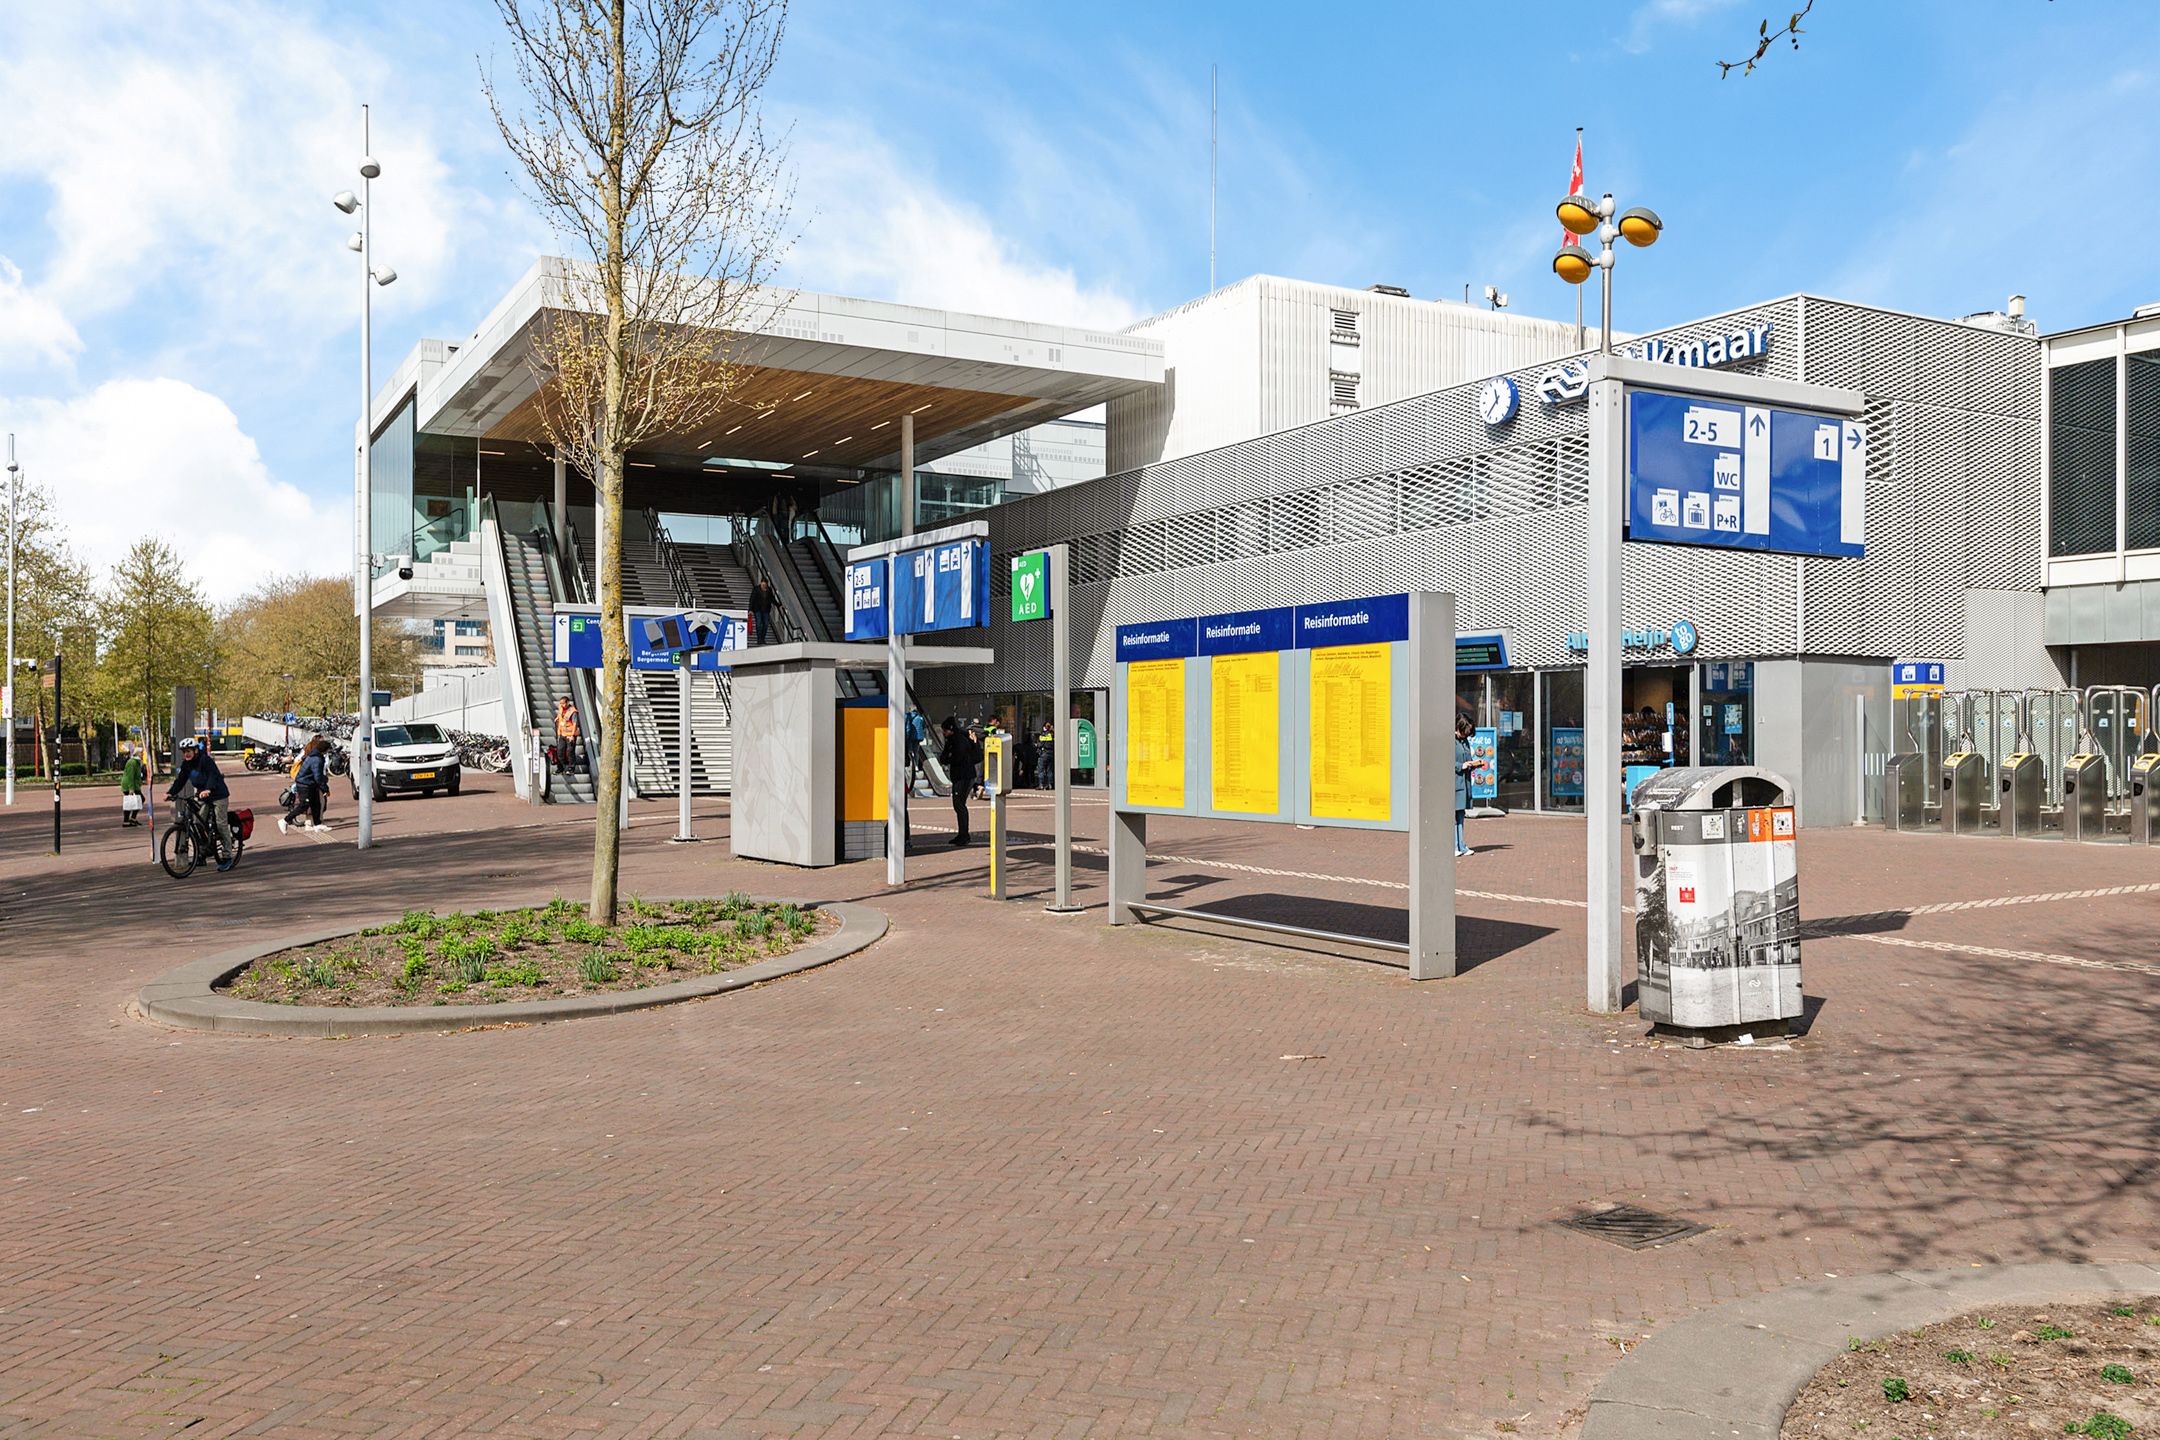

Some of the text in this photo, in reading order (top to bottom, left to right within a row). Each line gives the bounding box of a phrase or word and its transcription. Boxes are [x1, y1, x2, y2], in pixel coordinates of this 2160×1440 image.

[1622, 323, 1772, 368] lkmaar
[1688, 419, 1718, 442] 2-5
[1822, 437, 1830, 457] 1
[1716, 472, 1738, 487] WC
[1716, 513, 1738, 529] P+R
[855, 574, 865, 586] 2-5
[1018, 602, 1037, 615] AED
[1303, 611, 1370, 629] Reisinformatie
[1205, 621, 1261, 639] Reisinformatie
[1674, 625, 1687, 638] to
[1122, 631, 1170, 646] Reisinformatie
[1621, 628, 1665, 650] Heijn
[1679, 633, 1694, 650] go
[636, 656, 670, 664] Bergermeer
